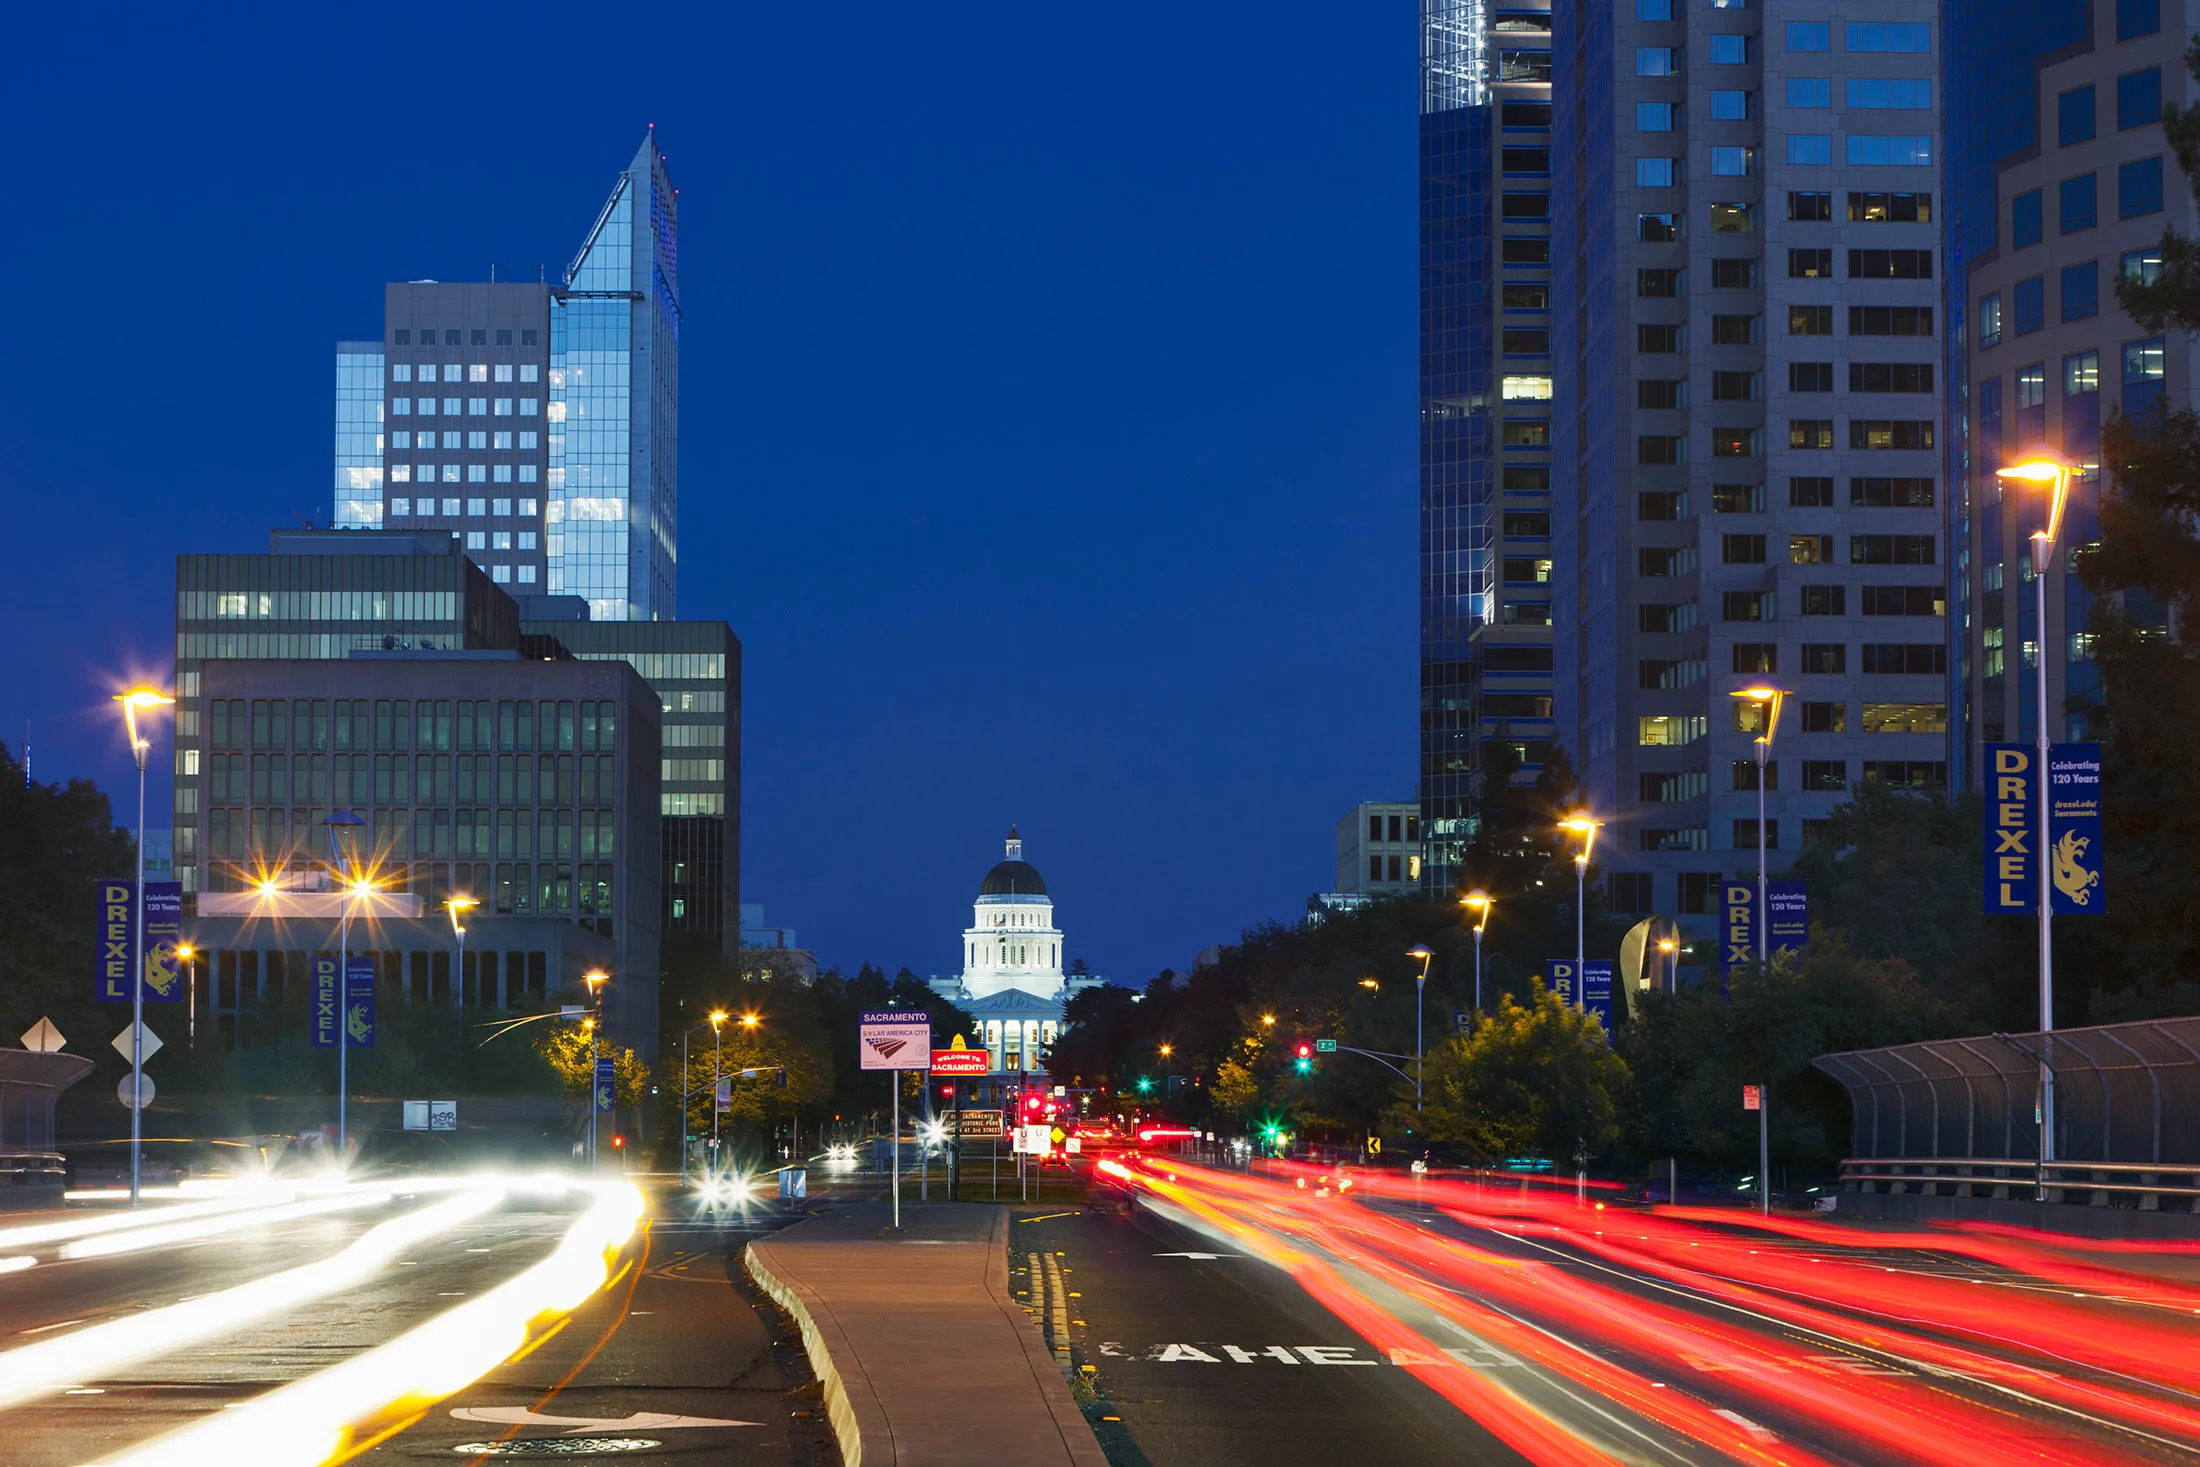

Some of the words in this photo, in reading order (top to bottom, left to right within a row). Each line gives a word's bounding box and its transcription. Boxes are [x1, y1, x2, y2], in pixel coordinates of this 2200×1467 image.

[2051, 761, 2100, 771] Celebrating
[2053, 774, 2071, 784] 120
[2072, 774, 2099, 783] Years
[1995, 750, 2029, 906] DREXEL
[1769, 893, 1807, 901] Celebrating
[1727, 887, 1752, 979] DREX
[104, 886, 129, 996] DREXEL
[1554, 965, 1572, 1006] DRE
[317, 961, 335, 1043] DREXEL
[863, 1013, 927, 1022] SACRAMENTO
[936, 1054, 971, 1063] WELCOME
[971, 1054, 981, 1062] TO
[931, 1063, 986, 1071] SACRAMENTO
